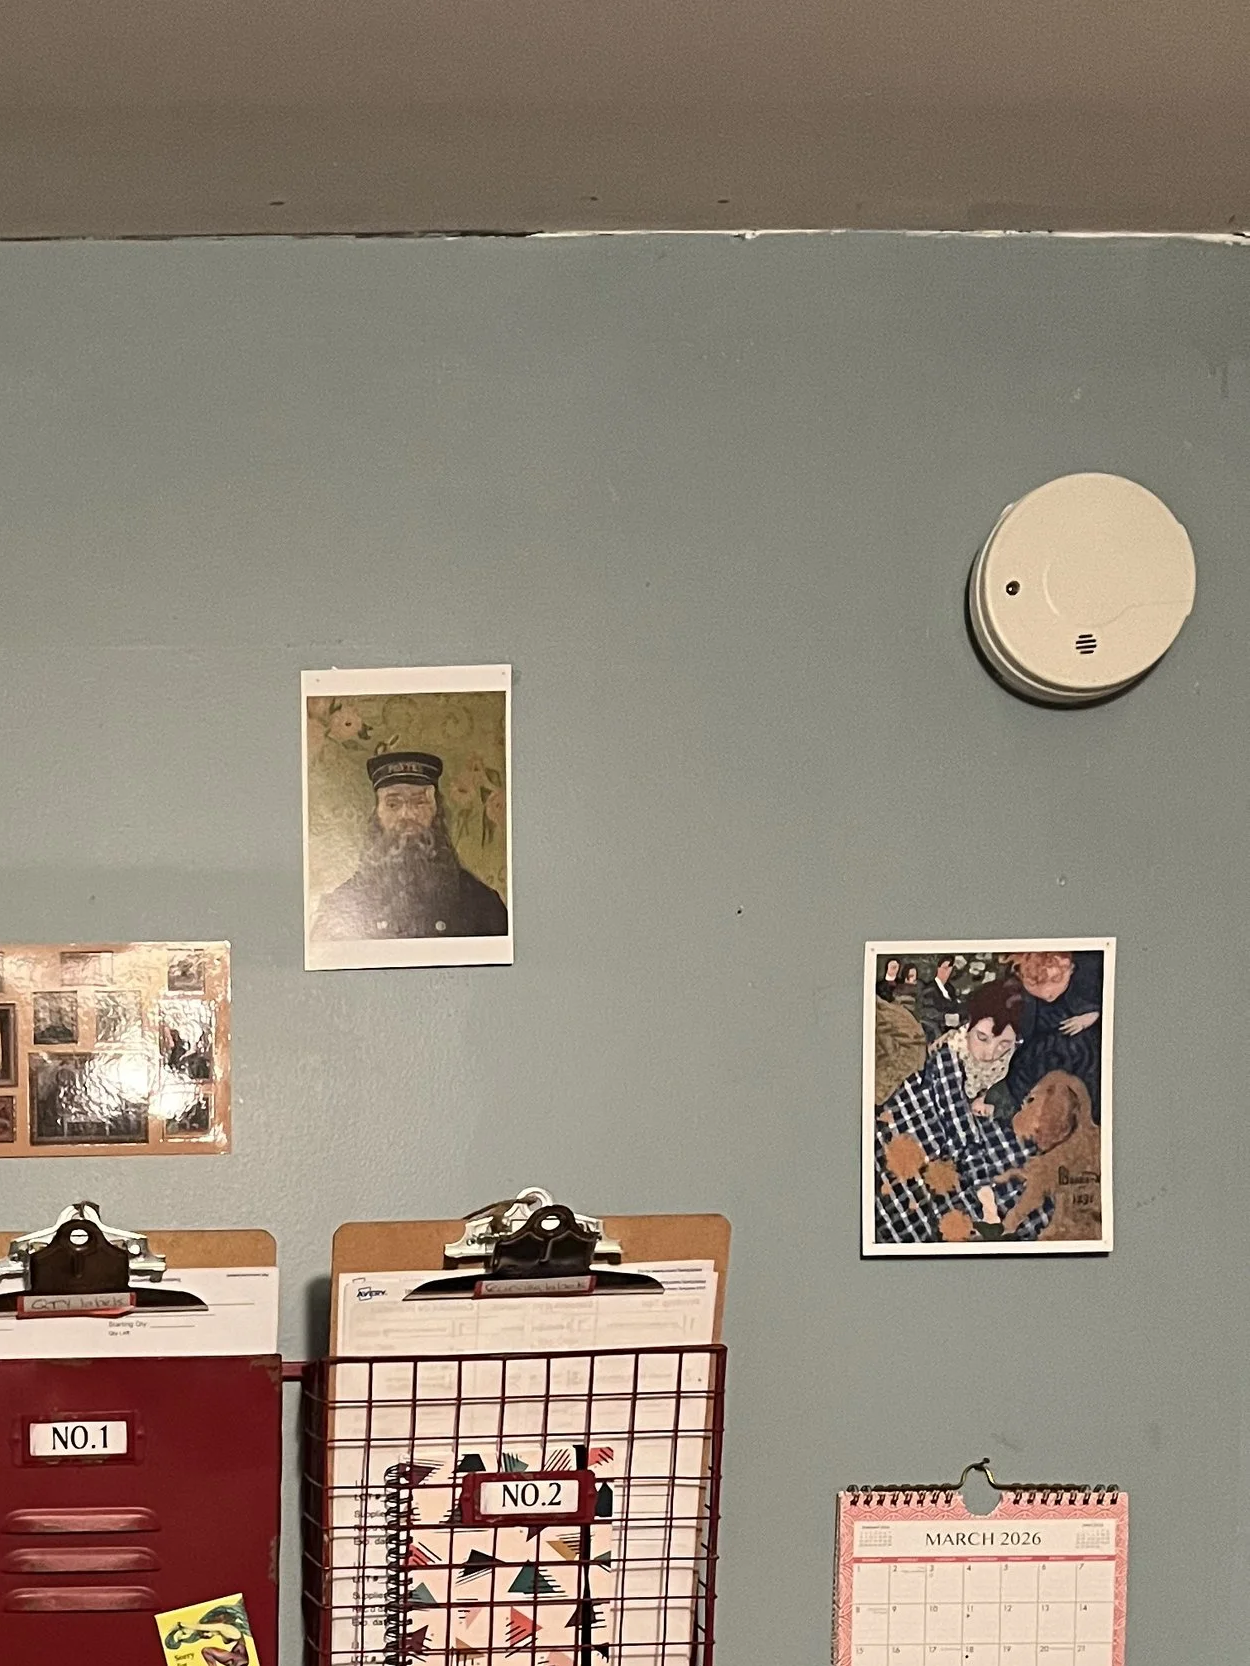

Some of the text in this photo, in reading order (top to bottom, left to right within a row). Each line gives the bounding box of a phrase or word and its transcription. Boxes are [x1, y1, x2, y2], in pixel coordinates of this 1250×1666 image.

[51, 1424, 109, 1450] NO.1
[501, 1483, 562, 1508] NO.2
[925, 1531, 1042, 1547] MARCH 2026
